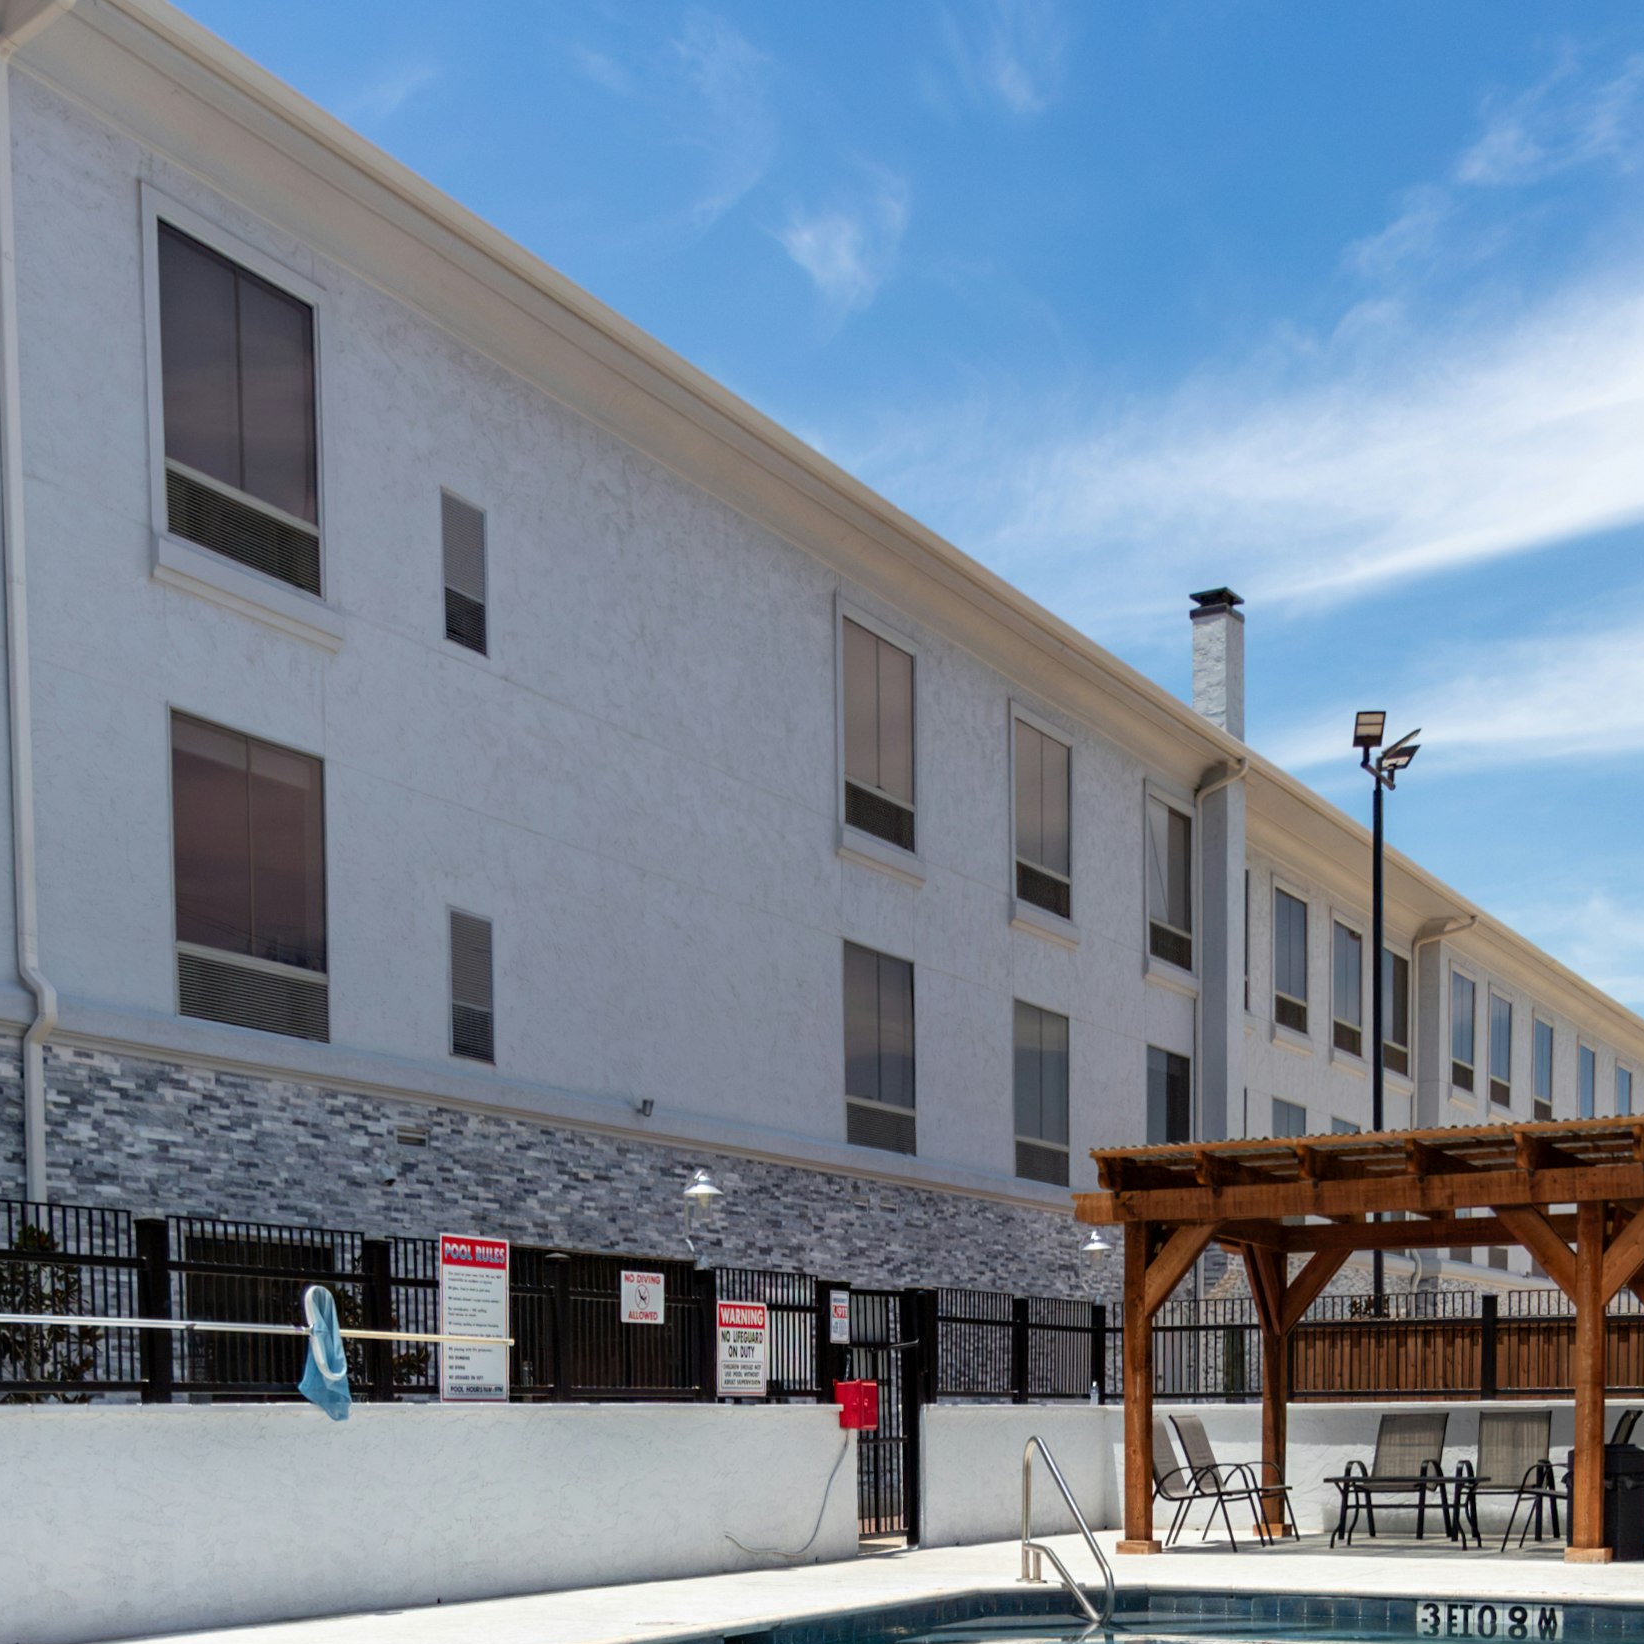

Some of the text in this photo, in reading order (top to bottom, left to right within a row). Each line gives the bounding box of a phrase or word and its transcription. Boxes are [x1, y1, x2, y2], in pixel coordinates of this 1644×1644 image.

[444, 1242, 505, 1264] POOL RULES
[624, 1273, 661, 1285] NO DIVING
[628, 1310, 659, 1321] ALLOWED
[720, 1307, 764, 1326] WARNING
[721, 1330, 763, 1344] NO LIFEGUARD
[728, 1345, 755, 1359] ON DUTY
